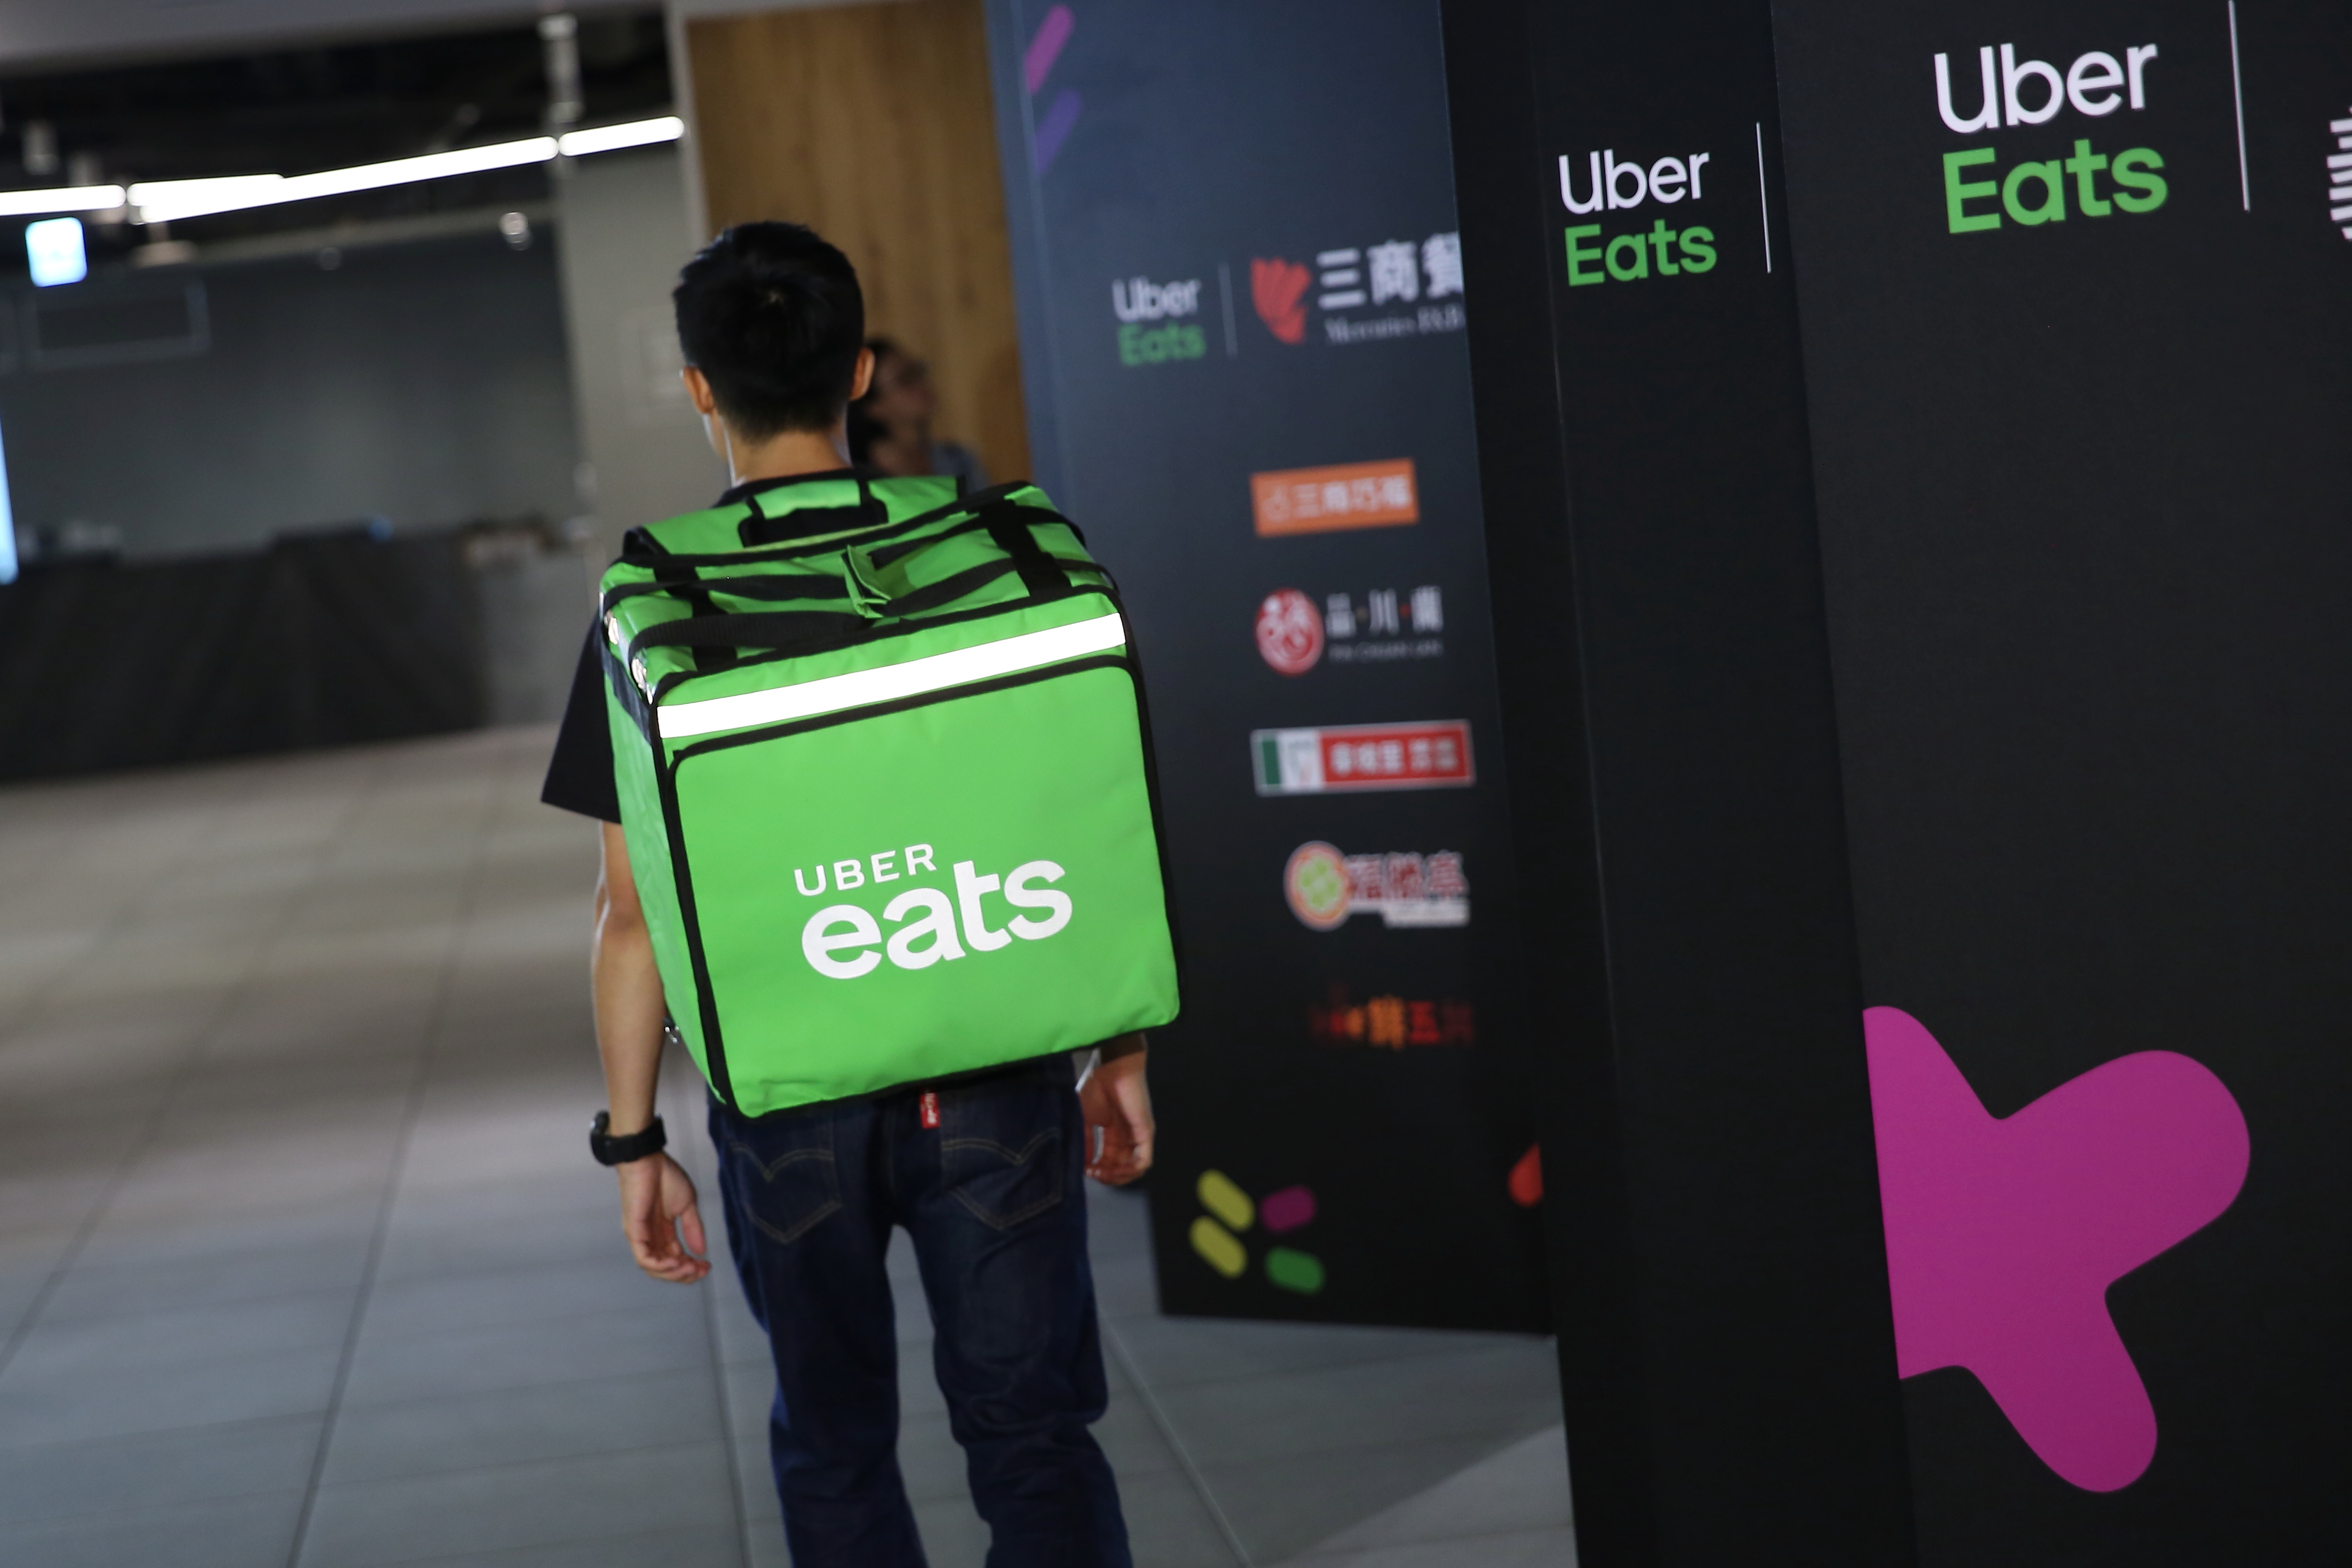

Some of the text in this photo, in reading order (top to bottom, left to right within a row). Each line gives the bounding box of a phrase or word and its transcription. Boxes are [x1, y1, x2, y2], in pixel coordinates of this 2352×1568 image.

[1933, 43, 2158, 134] Uber
[1558, 149, 1709, 214] Uber
[1943, 139, 2168, 234] Eats
[1565, 220, 1717, 286] Eats
[1112, 276, 1202, 322] Uber
[1116, 321, 1208, 367] Eats
[794, 843, 937, 897] UBER
[801, 860, 1073, 980] eats
